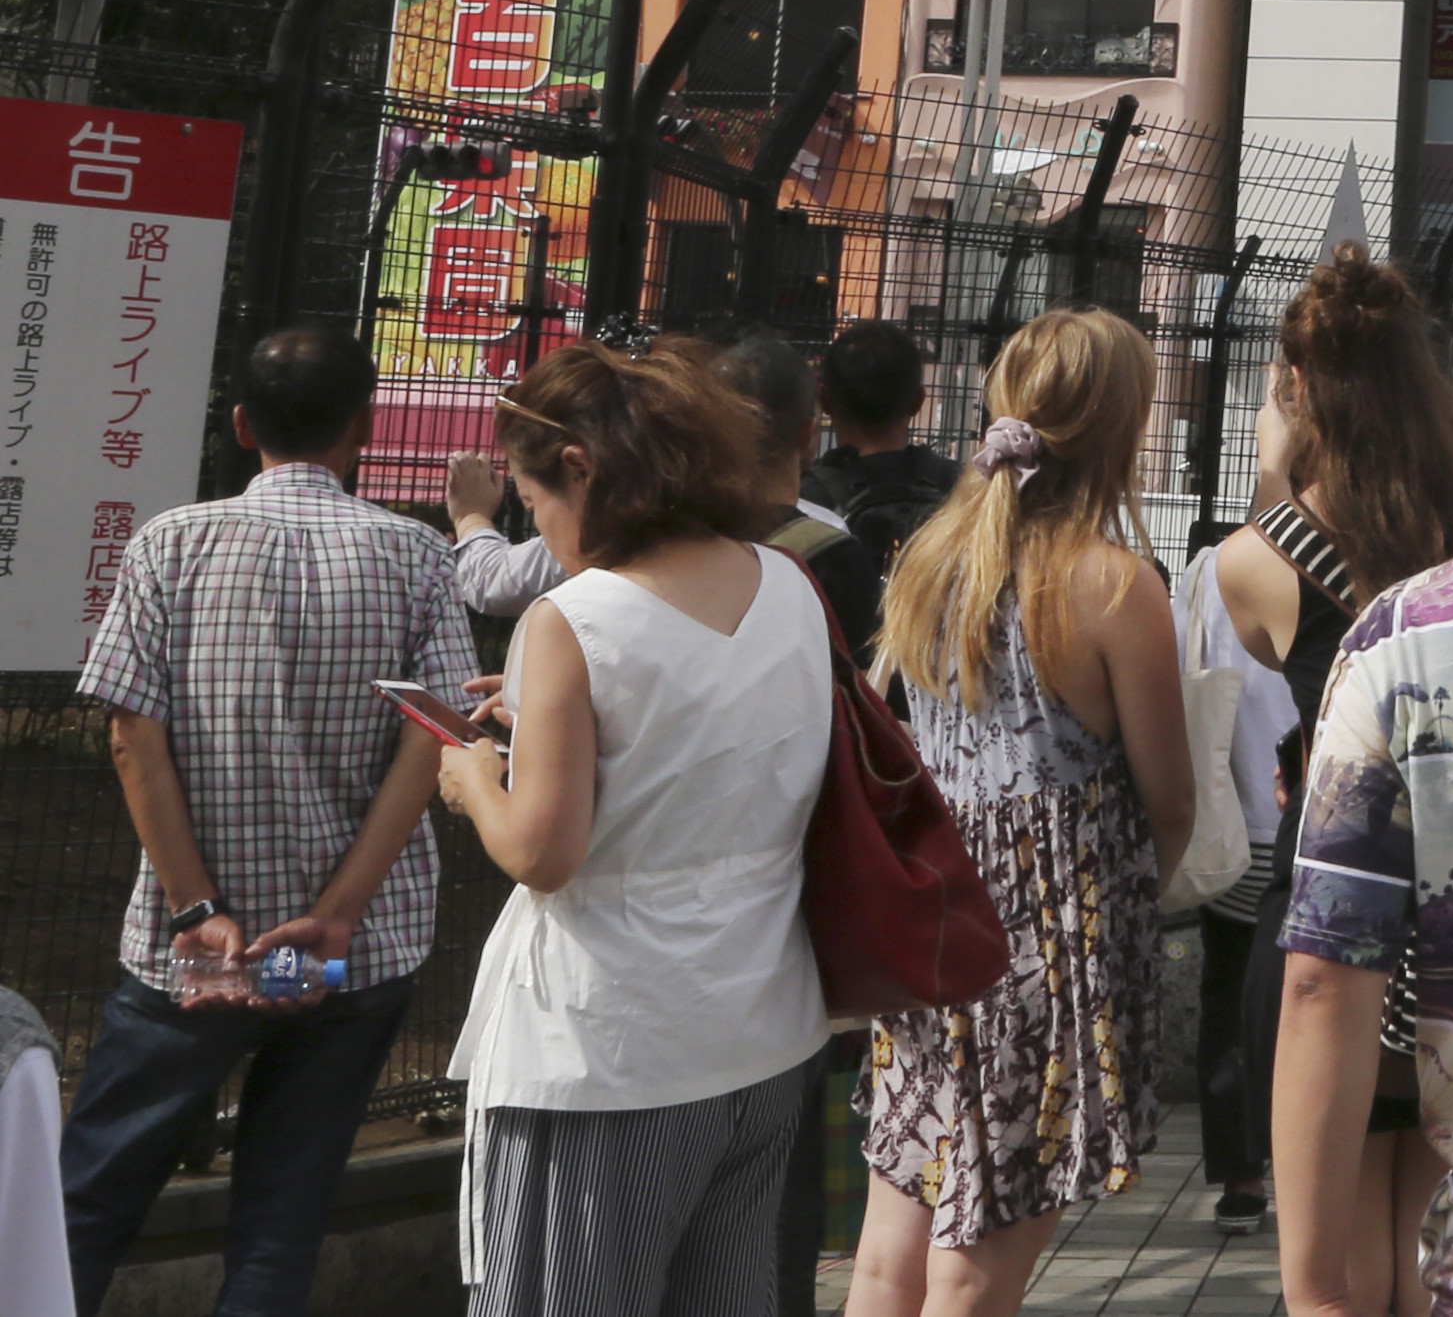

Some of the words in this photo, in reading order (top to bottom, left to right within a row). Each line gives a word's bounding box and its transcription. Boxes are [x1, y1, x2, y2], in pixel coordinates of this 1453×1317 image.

[69, 121, 141, 200] 告
[101, 223, 170, 469] 路上ライブ等
[373, 353, 520, 380] YAKKA
[78, 501, 136, 665] 露店禁
